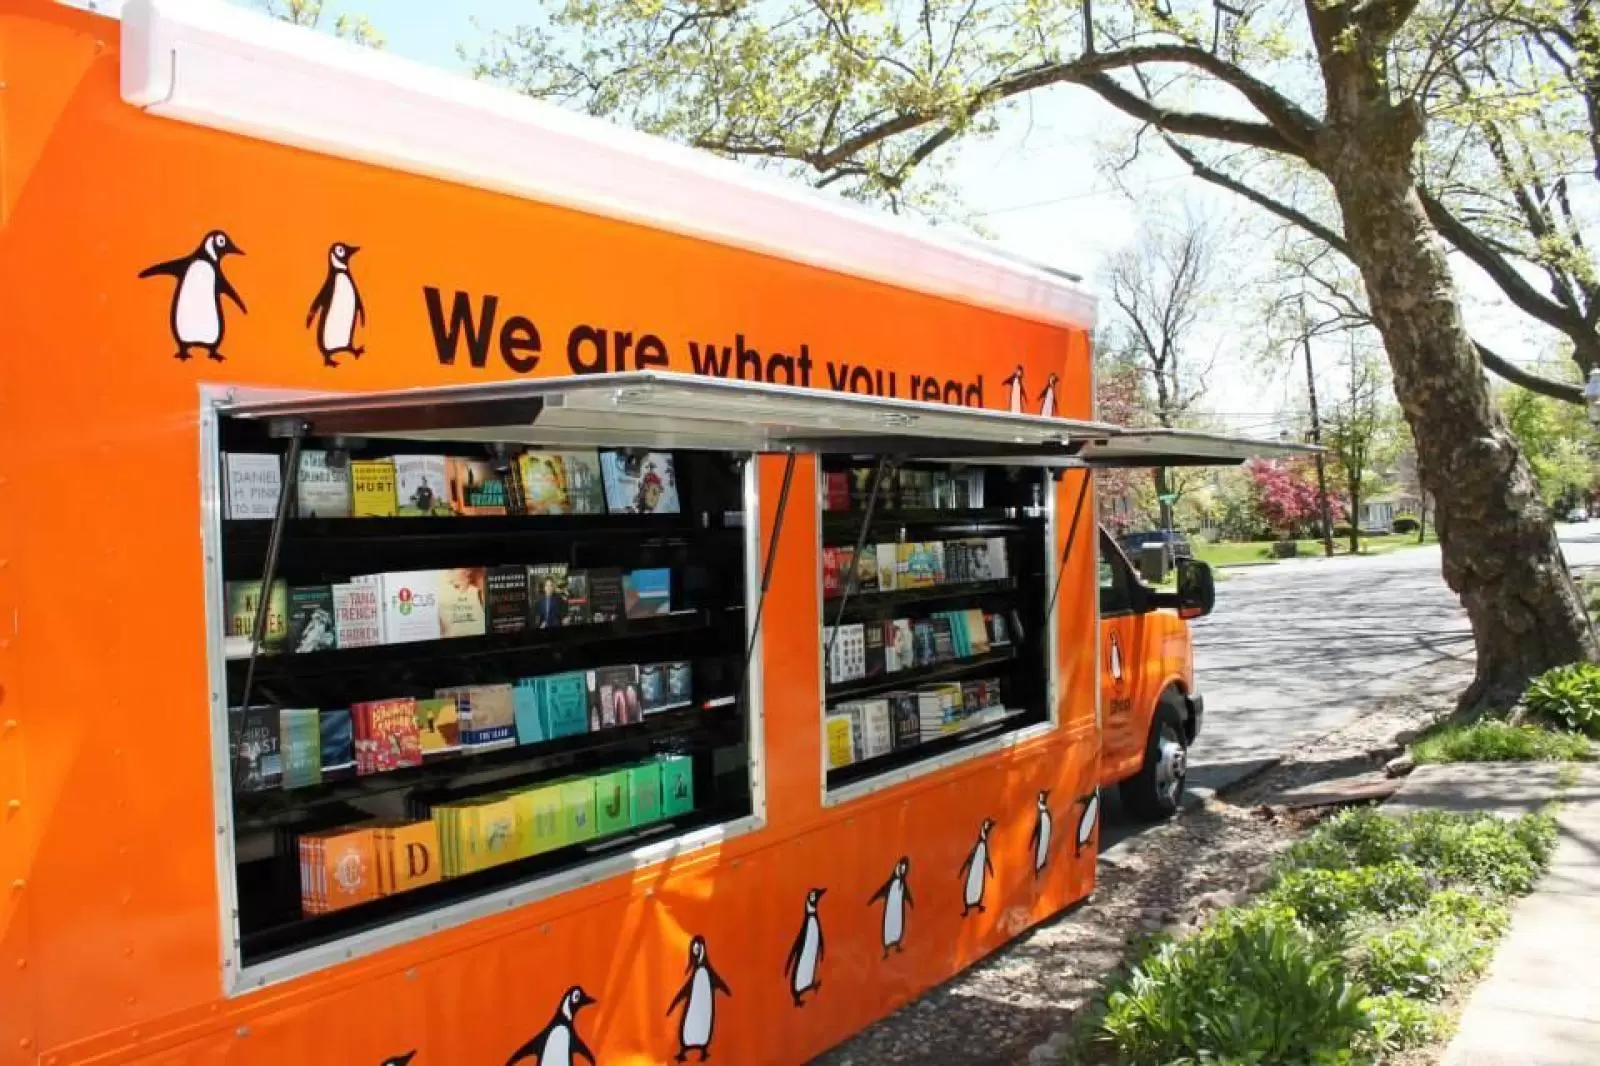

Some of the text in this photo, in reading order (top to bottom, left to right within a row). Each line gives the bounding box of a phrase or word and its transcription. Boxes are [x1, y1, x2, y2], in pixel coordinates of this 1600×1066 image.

[423, 286, 541, 373] We
[566, 323, 669, 375] are
[688, 335, 813, 388] what
[910, 373, 984, 408] read
[232, 470, 280, 484] DANIEL
[356, 482, 392, 493] HURT
[336, 606, 378, 621] FRENCH
[235, 614, 284, 635] RUER
[407, 842, 429, 880] D
